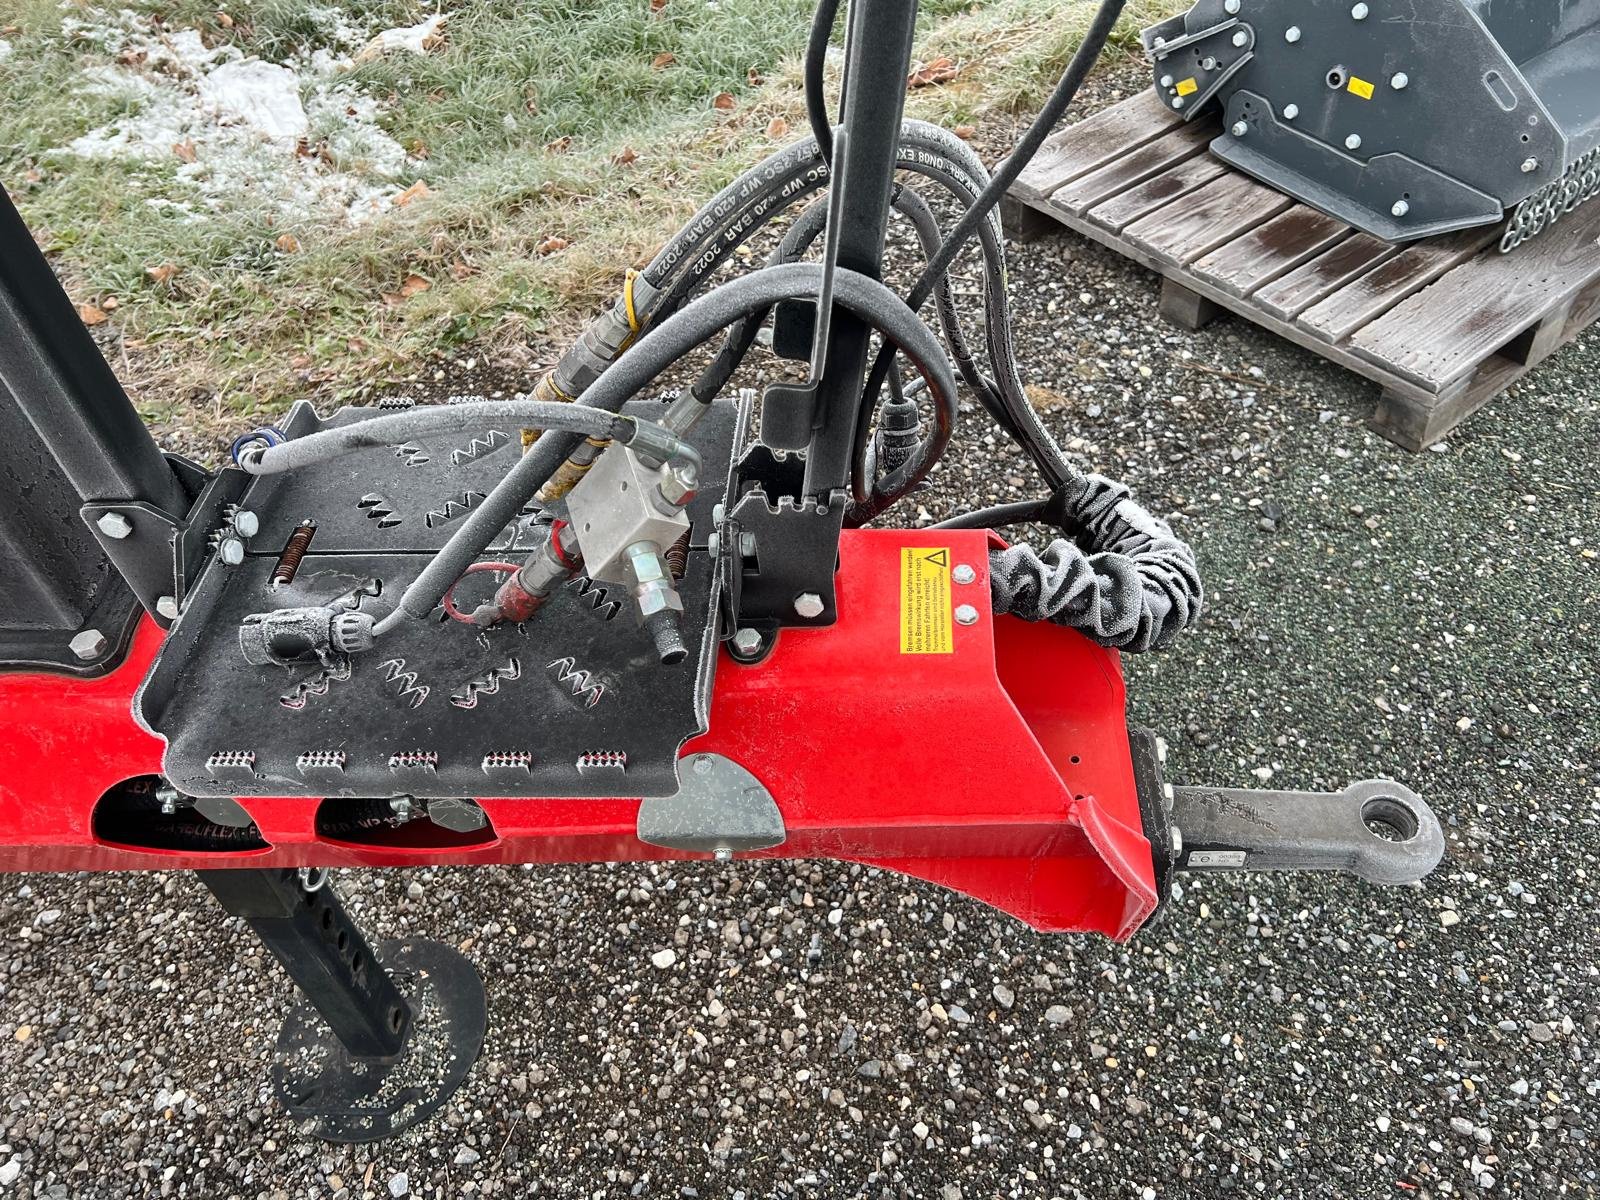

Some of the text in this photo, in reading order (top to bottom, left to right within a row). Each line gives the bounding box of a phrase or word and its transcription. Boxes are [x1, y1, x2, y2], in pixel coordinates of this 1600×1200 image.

[739, 176, 763, 199] WP
[781, 177, 806, 199] WP
[713, 196, 737, 218] 420
[686, 214, 714, 244] BAR
[724, 214, 753, 242] BAR
[691, 243, 721, 275] 2Q22
[915, 595, 923, 637] Bremswirkung
